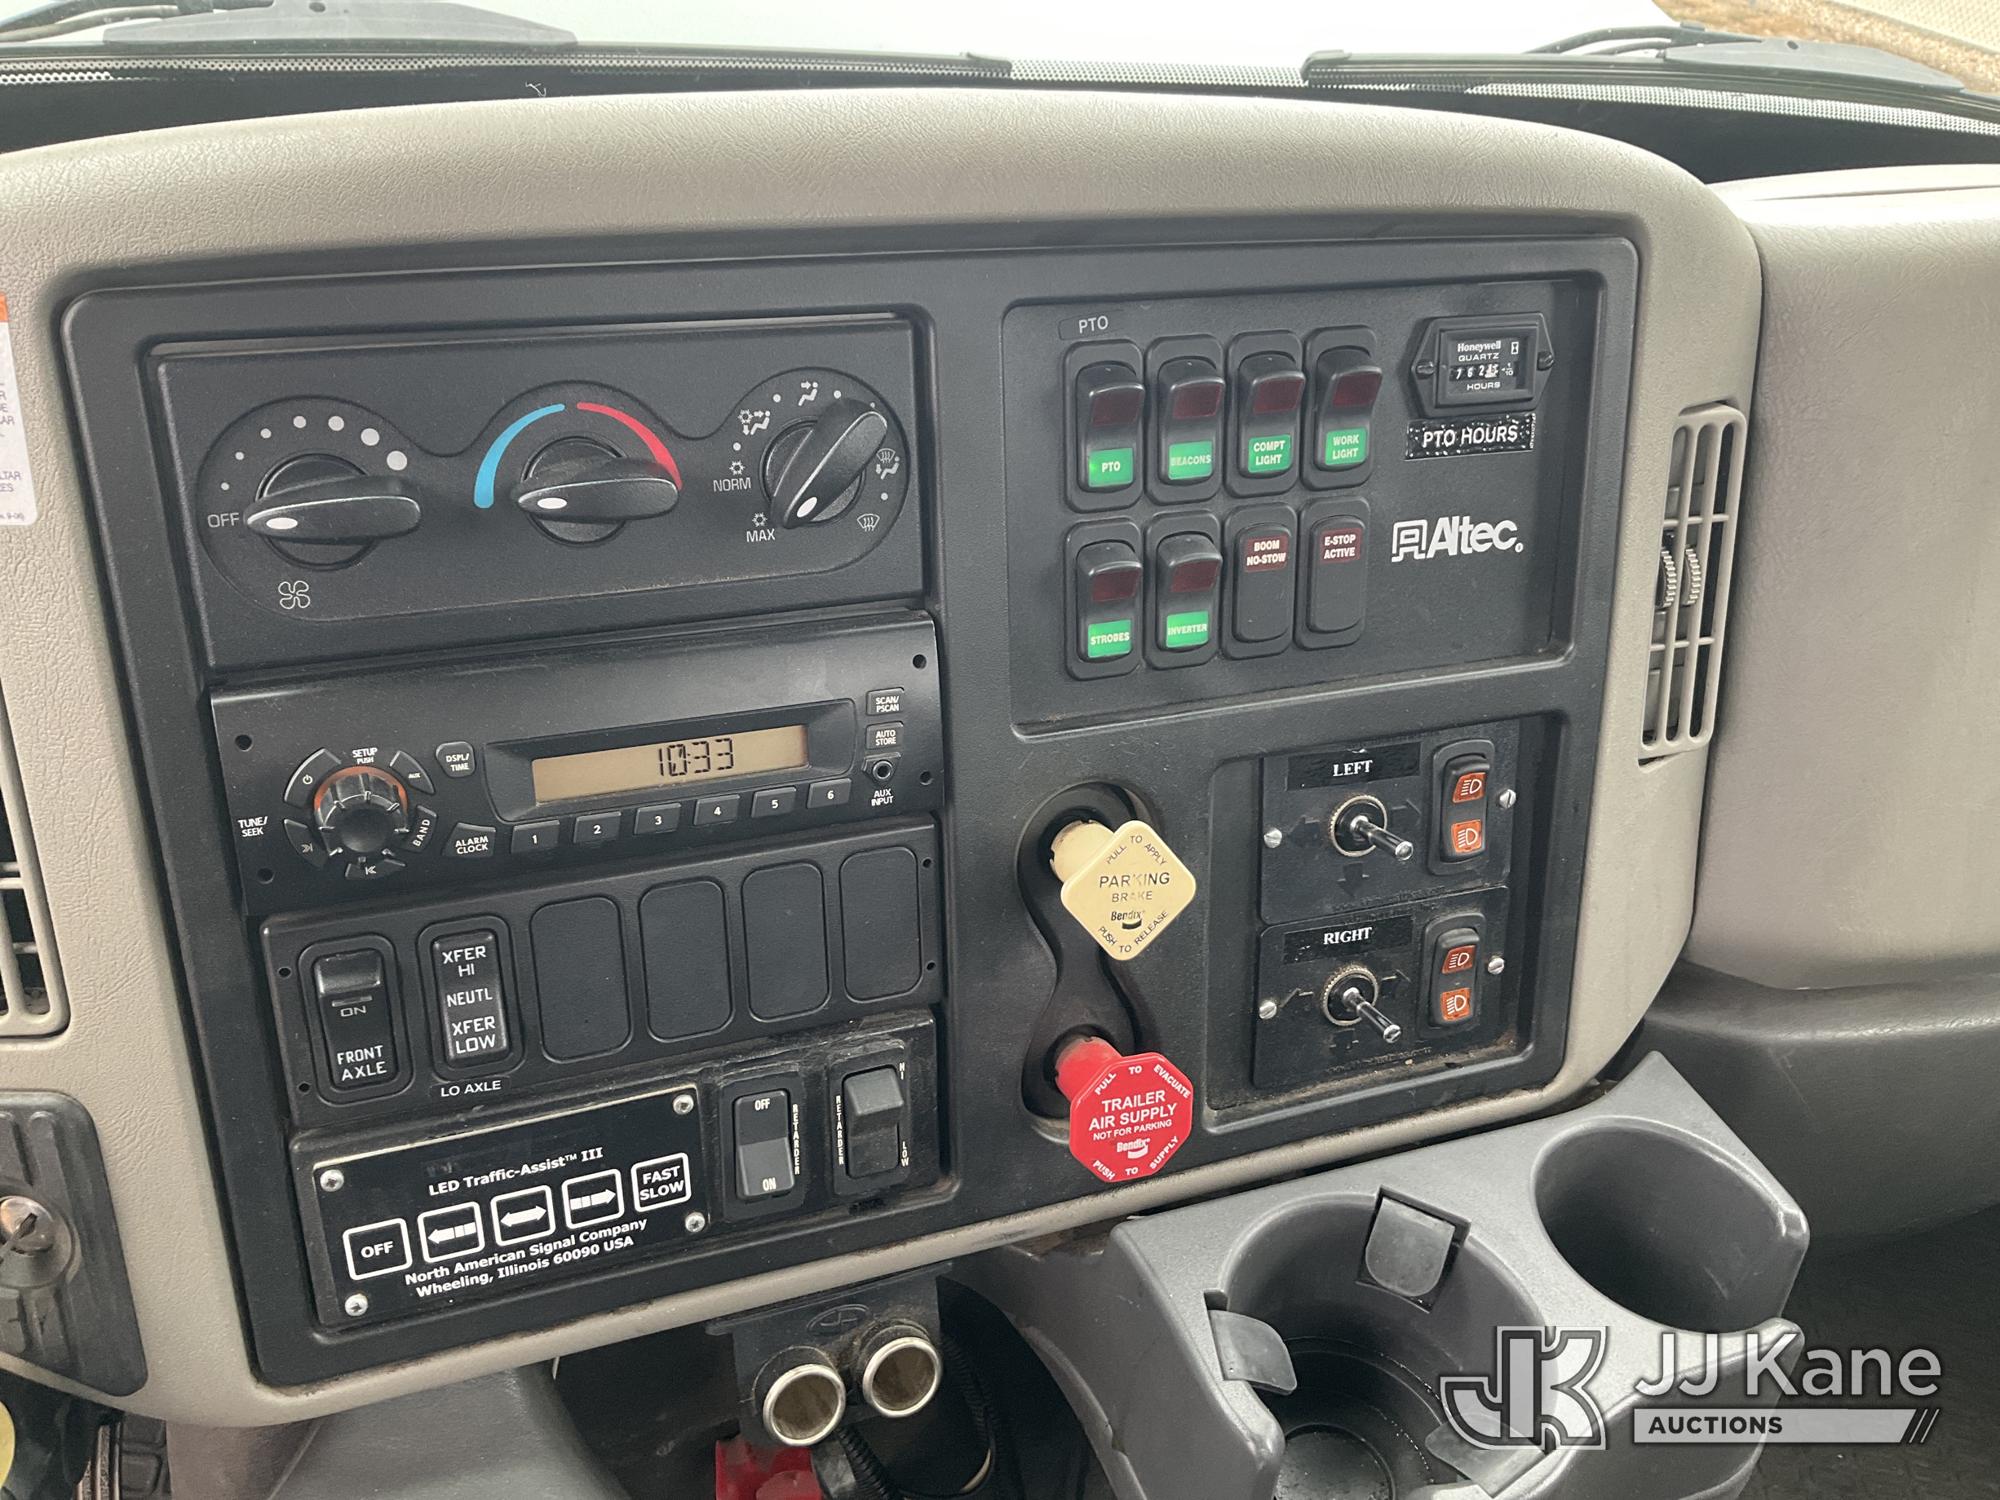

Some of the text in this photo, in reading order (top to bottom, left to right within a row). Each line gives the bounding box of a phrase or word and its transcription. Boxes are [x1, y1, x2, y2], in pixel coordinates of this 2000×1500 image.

[1078, 316, 1108, 334] PTO
[1457, 340, 1501, 353] Honeywell
[1458, 353, 1499, 362] QUARTZ
[1466, 381, 1501, 391] HOURS
[1333, 434, 1360, 446] WORK
[1422, 429, 1456, 448] PTO
[1460, 424, 1519, 446] HOURS
[1253, 440, 1286, 453] COMPT
[1255, 454, 1283, 466] LIGHT
[1332, 448, 1359, 460] LIGHT
[1101, 461, 1121, 473] PTO
[713, 477, 751, 492] NORM
[207, 512, 240, 528] OFF
[746, 528, 776, 542] MAX
[1324, 534, 1357, 546] E-STOP
[1253, 539, 1280, 552] BOOM
[1246, 552, 1286, 566] NO-STOW
[1323, 547, 1355, 559] ACTIVE
[1167, 623, 1208, 636] INVERTER
[1090, 632, 1131, 645] STROBES
[875, 695, 900, 705] SCAN/
[876, 703, 899, 713] PSCAN
[875, 729, 896, 739] AUTO
[875, 737, 897, 746] STORE
[352, 747, 378, 758] SETUP
[445, 753, 470, 763] DSPL/
[658, 737, 734, 777] 10:33
[450, 762, 470, 772] TIME
[1333, 759, 1373, 777] LEFT
[827, 790, 834, 800] 6
[873, 788, 892, 798] AUX
[771, 799, 779, 810] 5
[871, 796, 894, 807] INPUT
[713, 806, 722, 816] 4
[238, 815, 268, 828] TUNE/
[655, 815, 662, 826] 3
[241, 827, 264, 837] SEEK
[412, 818, 430, 847] BAND
[593, 824, 601, 835] 2
[455, 836, 489, 848] ALARM
[532, 834, 538, 845] 1
[456, 843, 489, 855] CLOCK
[1106, 835, 1168, 866] PULL TO APPLY
[1099, 872, 1170, 888] PARKING
[1098, 910, 1169, 953] PUSH TO RELEASE
[1323, 927, 1372, 945] RIGHT
[442, 945, 487, 965] XFER
[458, 963, 475, 977] HI
[446, 987, 493, 1008] NEUTL
[340, 1005, 367, 1017] ON
[452, 1016, 496, 1037] XFER
[455, 1034, 496, 1054] LOW
[337, 1045, 384, 1065] FRONT
[341, 1061, 387, 1081] AXLE
[899, 1062, 906, 1080] HI
[1094, 1064, 1191, 1098] PULL TO EVACUATE
[440, 1080, 501, 1097] LO AXLE
[754, 1098, 771, 1111] OFF
[1101, 1090, 1166, 1113] TRAILER
[1088, 1102, 1178, 1131] AIR SUPPLY
[836, 1095, 845, 1165] RETARDER
[1093, 1119, 1173, 1141] NOT FOR PARKING
[792, 1103, 800, 1175] RETARDER
[901, 1141, 910, 1167] LOW
[1093, 1135, 1179, 1180] PUSH TO SUPPLY
[428, 1180, 460, 1196] LED
[580, 1147, 604, 1162] III
[642, 1165, 681, 1185] FAST
[639, 1180, 685, 1201] SLOW
[762, 1178, 777, 1191] ON
[360, 1241, 394, 1259] OFF
[405, 1218, 648, 1285] North American Signal Company
[416, 1236, 634, 1297] Wheeling, Illinois 60090 USA
